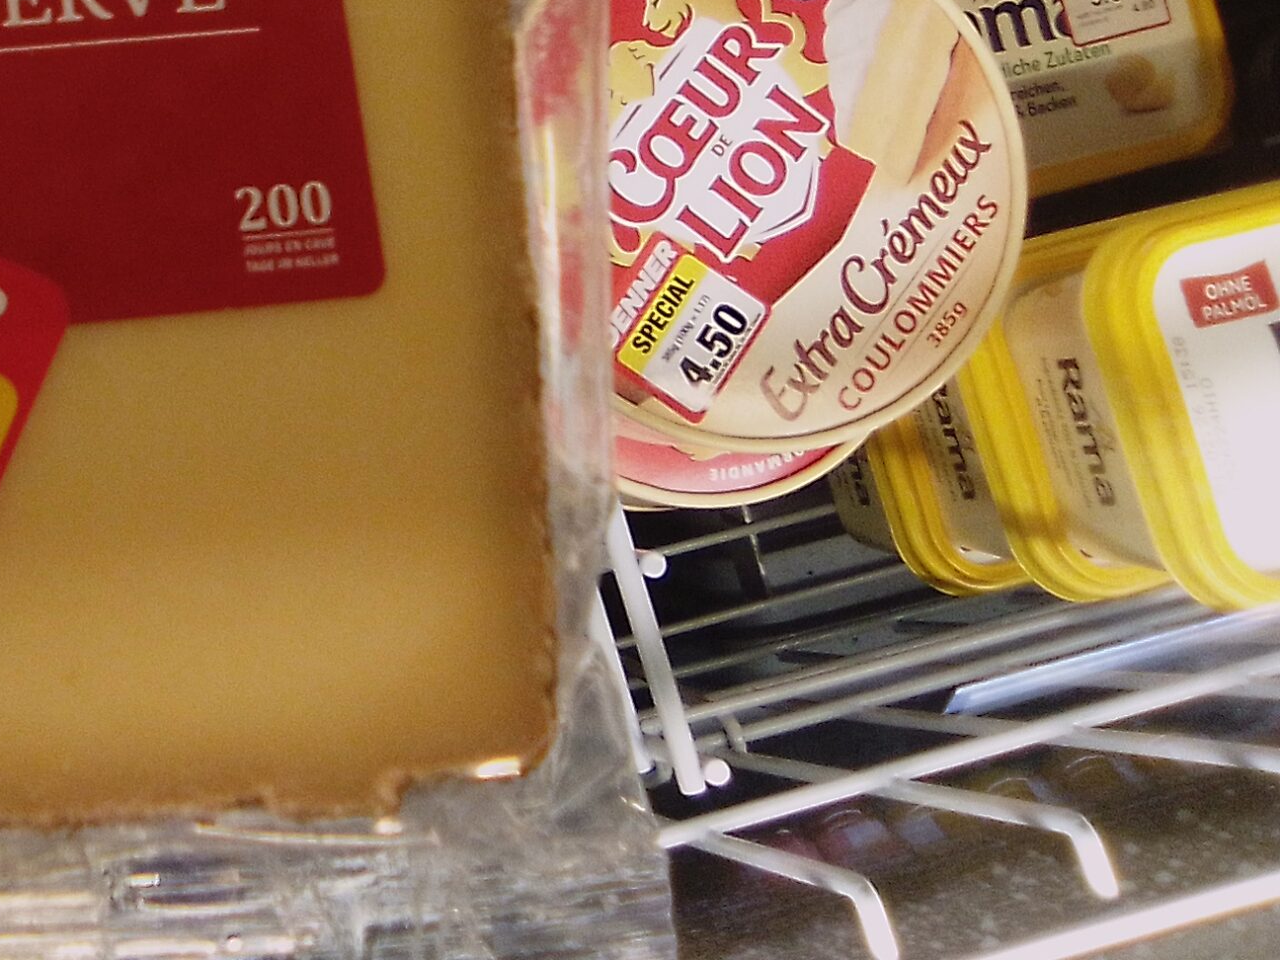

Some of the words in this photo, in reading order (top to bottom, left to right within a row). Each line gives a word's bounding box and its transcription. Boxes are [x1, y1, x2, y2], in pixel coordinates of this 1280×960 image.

[1044, 43, 1112, 69] Zutaten
[676, 83, 827, 258] LION
[711, 134, 733, 158] DE
[234, 180, 332, 232] 200
[613, 237, 678, 331] ENNER
[631, 274, 696, 357] SPECIAL
[837, 194, 1000, 412] COULOMMIERS
[927, 301, 969, 350] 385g
[1202, 273, 1254, 301] OHNE
[680, 303, 748, 386] 4.50
[1056, 357, 1114, 507] Rama
